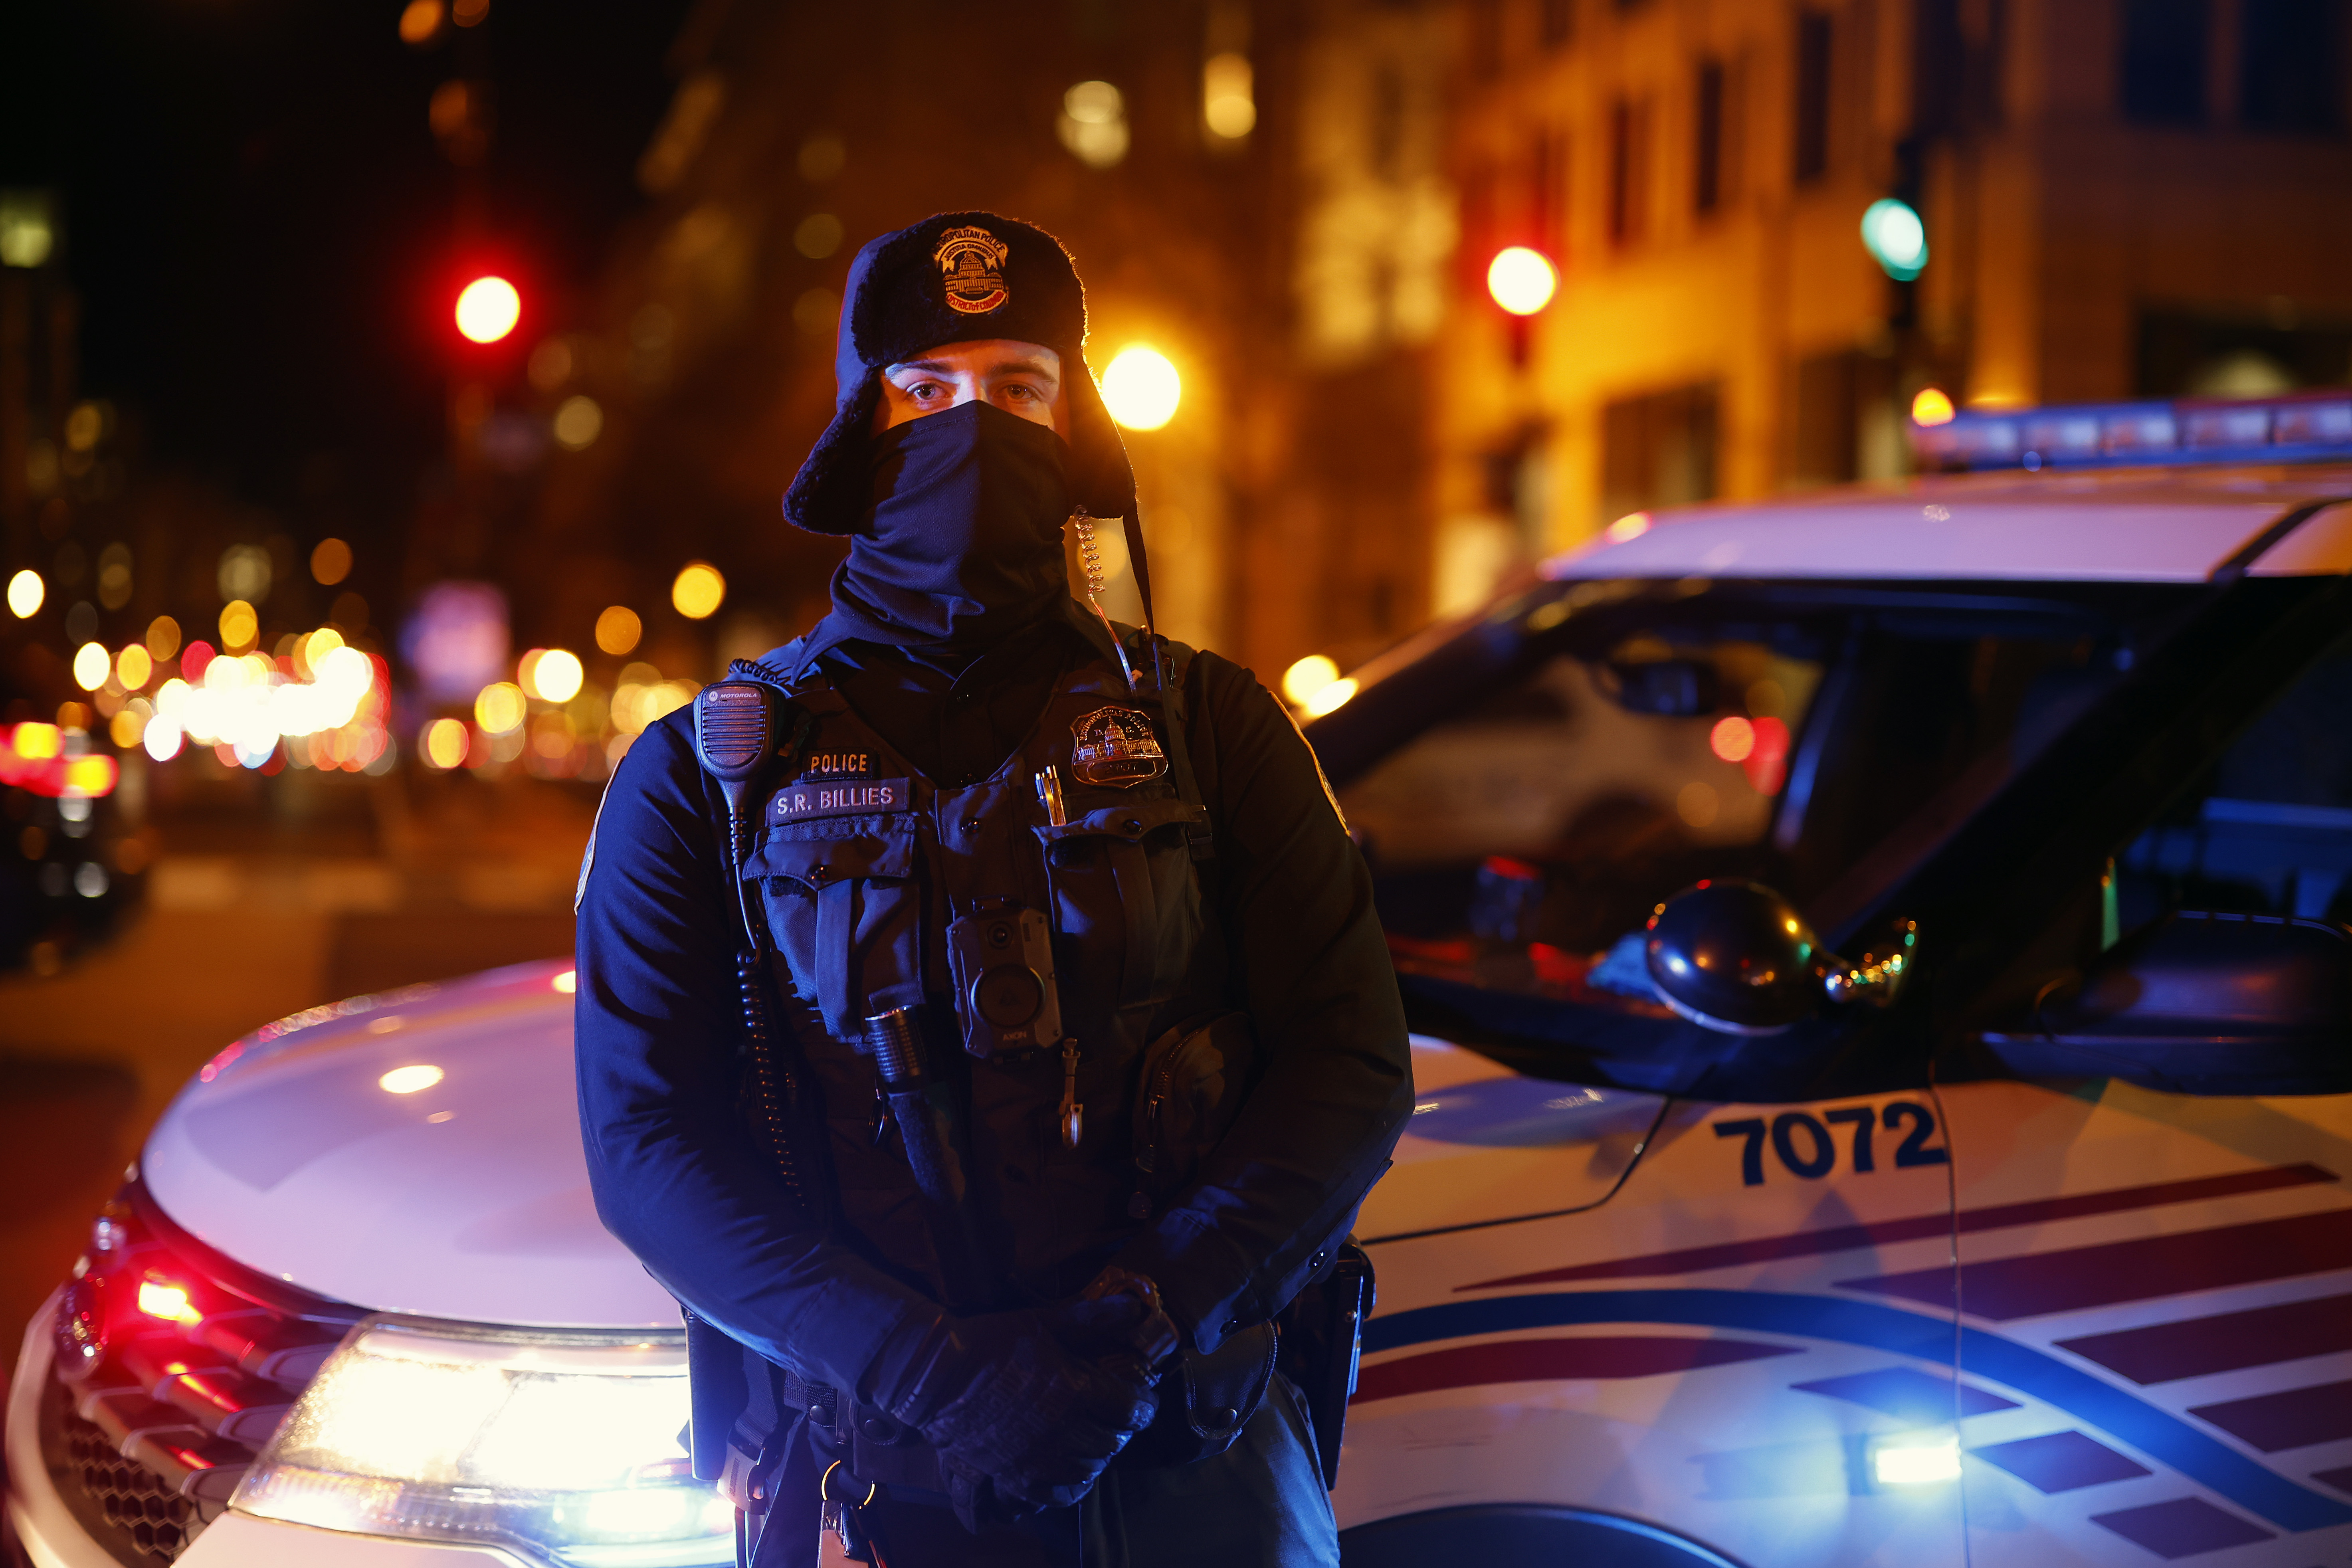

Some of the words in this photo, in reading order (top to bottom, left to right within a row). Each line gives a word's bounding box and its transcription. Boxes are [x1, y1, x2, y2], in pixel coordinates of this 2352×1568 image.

[936, 229, 980, 248] ROPOLITAN
[981, 234, 1005, 253] POLICE
[946, 294, 972, 310] DISTRICT
[972, 302, 979, 311] of
[810, 753, 867, 774] POLICE
[1105, 762, 1138, 774] 2107
[777, 793, 814, 815] S.R.
[820, 786, 894, 809] BILLIES
[1002, 1031, 1028, 1041] AXON
[1713, 1101, 1949, 1186] 7072
